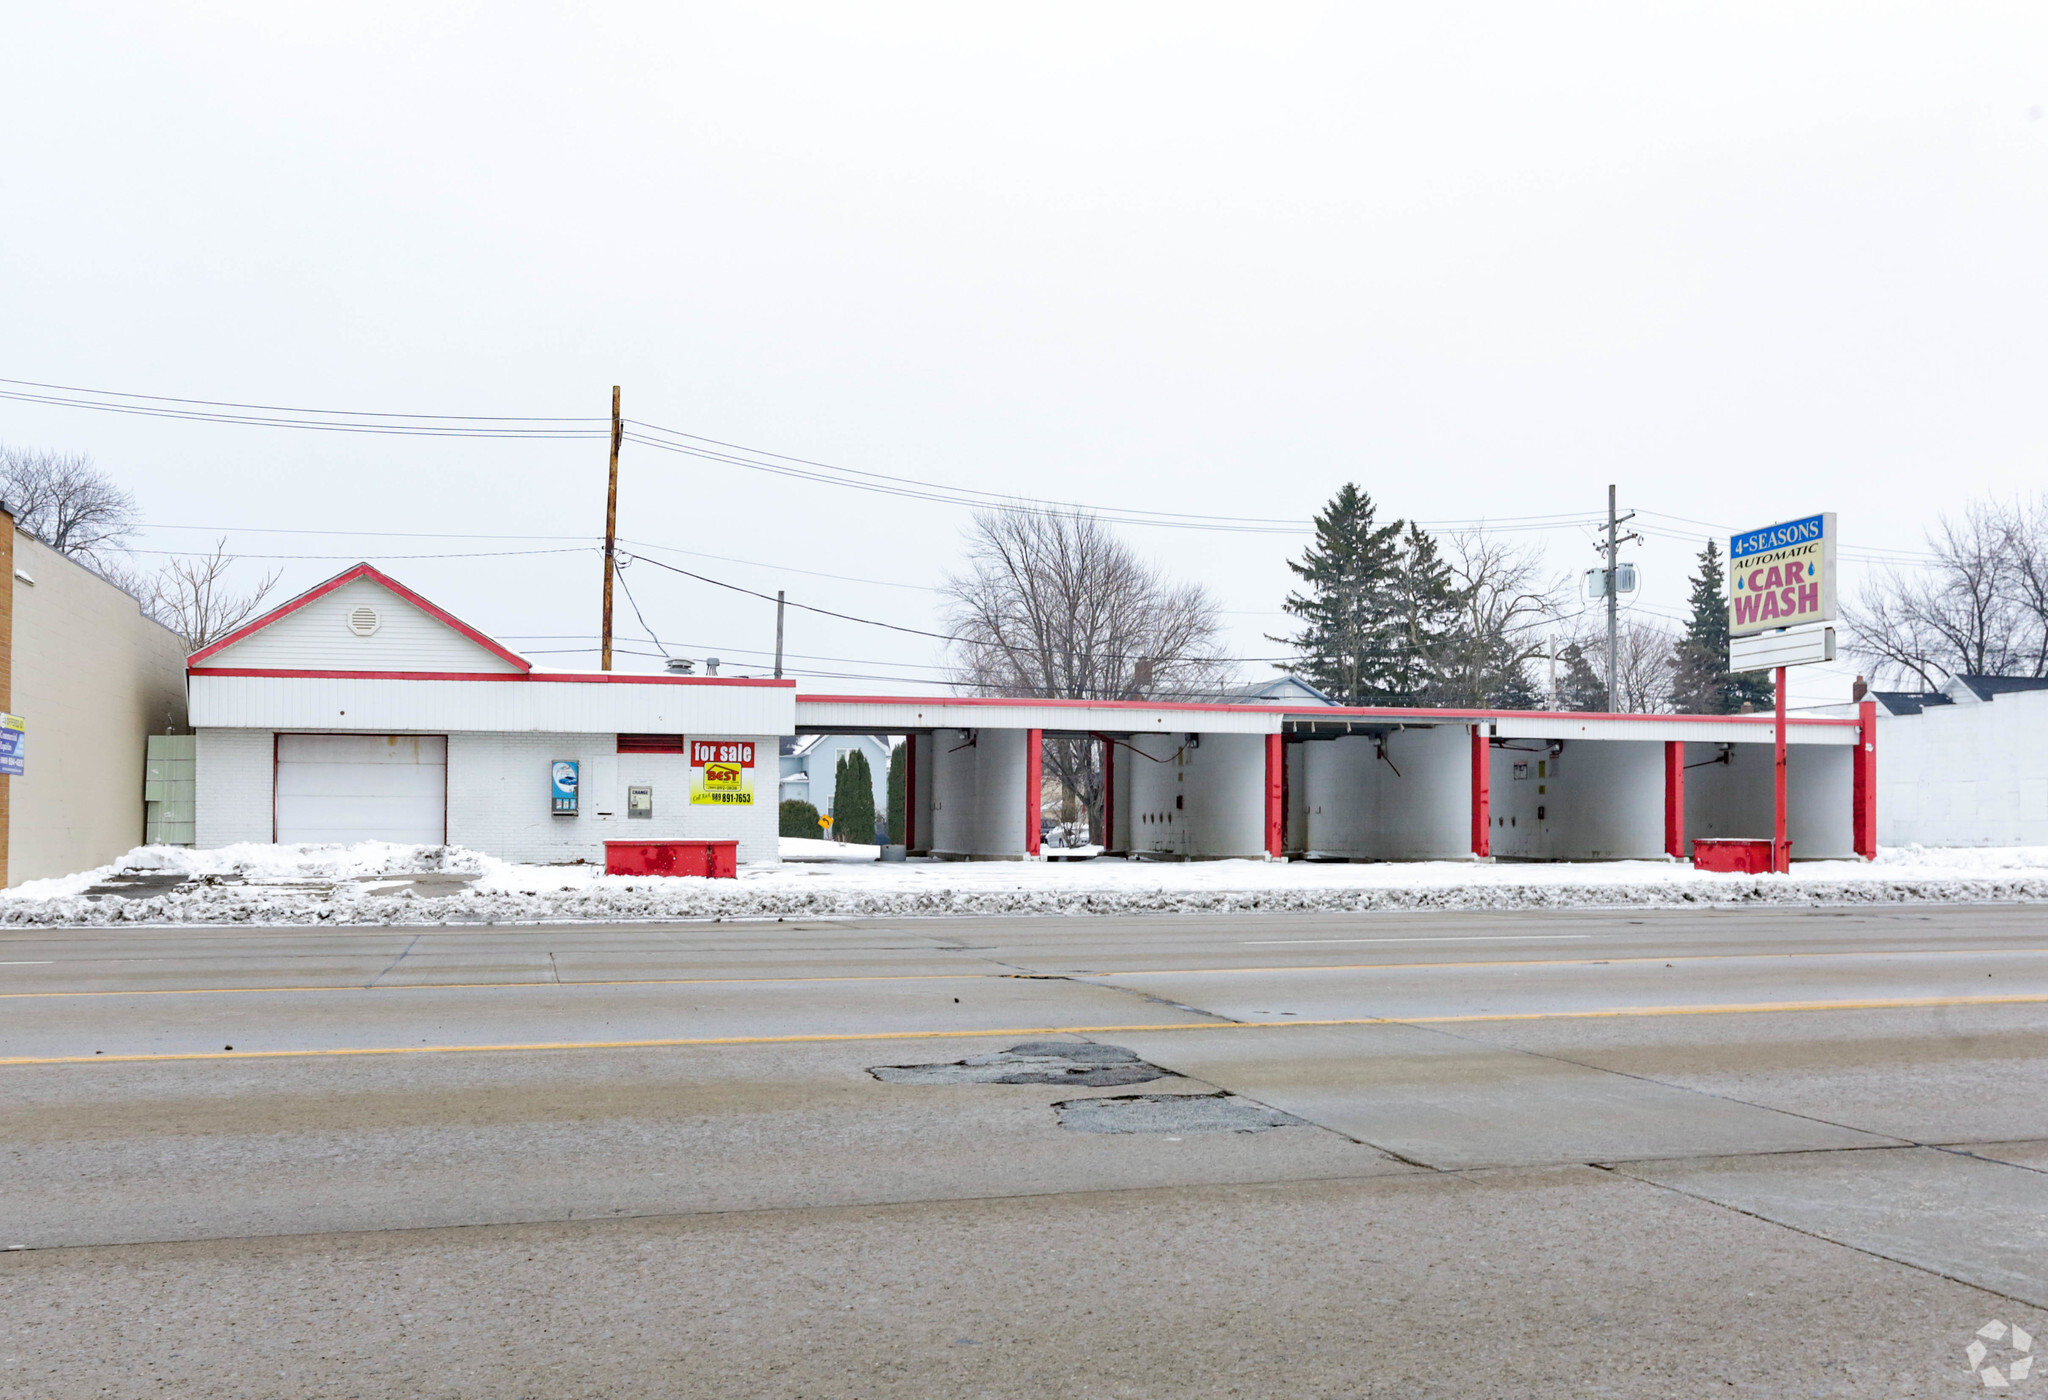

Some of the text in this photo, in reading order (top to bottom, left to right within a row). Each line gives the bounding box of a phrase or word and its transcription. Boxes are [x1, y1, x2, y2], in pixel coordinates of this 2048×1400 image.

[1735, 521, 1819, 554] 4-SEASONS
[1734, 543, 1819, 570] AUTOMATIC
[1748, 561, 1805, 592] CAR
[1734, 582, 1818, 625] WASH
[695, 743, 752, 762] for sale
[706, 770, 739, 781] BEST
